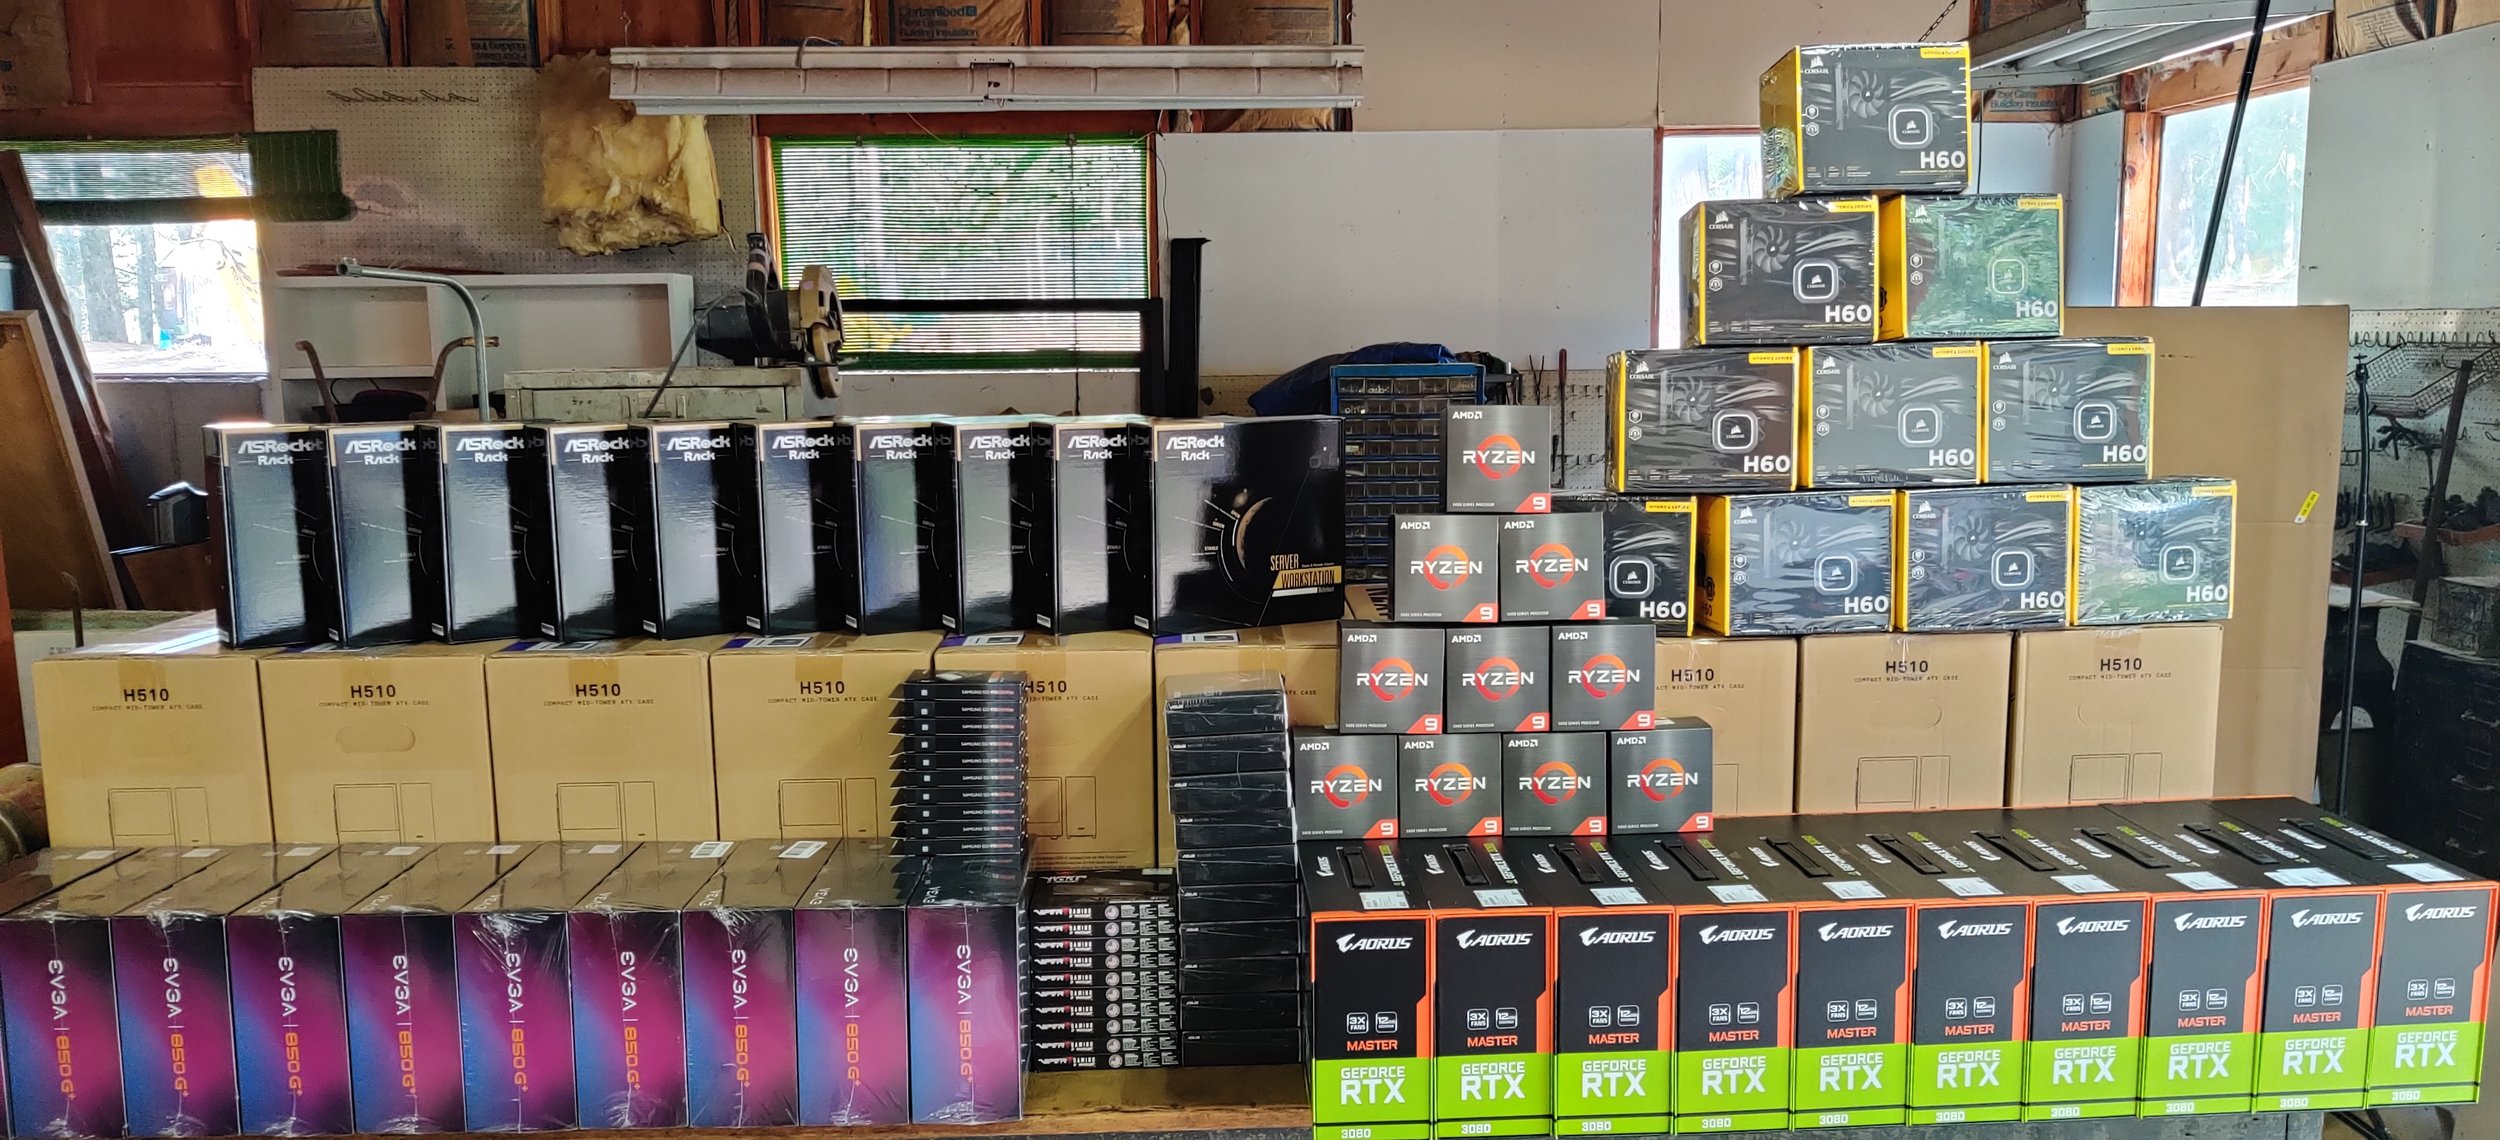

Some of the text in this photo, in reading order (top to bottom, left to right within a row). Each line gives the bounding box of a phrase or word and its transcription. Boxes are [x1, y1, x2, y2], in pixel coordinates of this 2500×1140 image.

[1921, 151, 1965, 168] H60
[1826, 305, 1871, 322] H60
[2016, 301, 2058, 317] H60
[1452, 411, 1474, 420] AMD
[238, 437, 312, 453] ASRock
[345, 437, 416, 453] ASRock
[456, 437, 523, 451] ASRock
[565, 437, 629, 452] ASRock
[666, 437, 730, 451] ASRock
[772, 436, 834, 449] ASRock
[869, 436, 932, 449] ASRock
[969, 436, 1030, 448] ASRock
[1068, 436, 1126, 448] ASRock
[1166, 436, 1224, 449] ASRock
[1463, 448, 1535, 464] RYZEN
[1929, 449, 1974, 467] H60
[2103, 445, 2147, 463] H60
[1744, 456, 1790, 472] H60
[1533, 497, 1546, 510] 9
[1400, 521, 1422, 530] AMD
[1504, 521, 1526, 529] AMD
[1270, 554, 1299, 571] SERVER
[1411, 558, 1482, 574] RYZEN
[1516, 557, 1588, 573] RYZEN
[1281, 570, 1335, 588] WORKSTATION
[2021, 591, 2064, 609] H60
[2186, 585, 2228, 602] H60
[1587, 604, 1600, 616] 9
[1640, 602, 1685, 618] H60
[1844, 596, 1888, 614] H60
[1480, 607, 1493, 620] 9
[1347, 635, 1368, 644] AMD
[1452, 635, 1473, 644] AMD
[1558, 632, 1579, 641] AMD
[1886, 661, 1928, 673] H510
[2101, 658, 2141, 671] H510
[1357, 673, 1428, 686] RYZEN
[1463, 670, 1533, 686] RYZEN
[1569, 667, 1640, 683] RYZEN
[1672, 669, 1714, 681] H510
[351, 685, 395, 698] H510
[576, 684, 620, 697] H510
[801, 681, 844, 694] H510
[1024, 681, 1067, 693] H510
[123, 689, 169, 702] H510
[1425, 718, 1437, 731] 9
[1532, 716, 1544, 728] 9
[1638, 714, 1650, 726] 9
[1300, 742, 1321, 751] AMD
[1404, 741, 1426, 750] AMD
[1509, 739, 1530, 748] AMD
[1617, 737, 1638, 746] AMD
[1311, 779, 1381, 793] RYZEN
[1416, 777, 1485, 791] RYZEN
[1520, 776, 1590, 789] RYZEN
[1628, 773, 1697, 787] RYZEN
[1381, 823, 1393, 835] 9
[1485, 821, 1497, 832] 9
[1590, 820, 1601, 832] 9
[1696, 816, 1708, 828] 9
[2306, 912, 2363, 928] AORUS
[2420, 906, 2477, 921] AORUS
[2072, 920, 2131, 935] AORUS
[2189, 916, 2247, 931] AORUS
[1595, 930, 1656, 946] AORUS
[1715, 928, 1775, 944] AORUS
[1833, 926, 1893, 941] AORUS
[1953, 923, 2013, 939] AORUS
[1351, 937, 1412, 952] AORUS
[1472, 933, 1532, 948] AORUS
[732, 949, 748, 1008] EVGA
[843, 947, 859, 1007] EVGA
[956, 944, 972, 1003] EVGA
[163, 957, 182, 1018] EVGA
[278, 956, 298, 1016] EVGA
[392, 955, 411, 1015] EVGA
[506, 953, 524, 1013] EVGA
[619, 951, 637, 1011] EVGA
[48, 959, 68, 1020] EVGA
[2293, 1011, 2341, 1023] MASTER
[2405, 1005, 2452, 1016] MASTER
[2062, 1020, 2111, 1031] MASTER
[2178, 1016, 2226, 1027] MASTER
[1709, 1030, 1759, 1042] MASTER
[1827, 1027, 1876, 1038] MASTER
[1945, 1025, 1994, 1035] MASTER
[1468, 1036, 1517, 1046] MASTER
[1589, 1034, 1638, 1043] MASTER
[2285, 1037, 2345, 1051] GEFORCE
[2397, 1030, 2458, 1045] GEFORCE
[1347, 1040, 1397, 1050] MASTER
[2170, 1042, 2231, 1056] GEFORCE
[1820, 1052, 1883, 1066] GEFORCE
[1938, 1049, 2000, 1063] GEFORCE
[2053, 1045, 2116, 1060] GEFORCE
[2394, 1043, 2455, 1068] RTX
[1461, 1062, 1525, 1076] GEFORCE
[1582, 1059, 1646, 1072] GEFORCE
[1702, 1056, 1766, 1069] GEFORCE
[2168, 1054, 2230, 1079] RTX
[2282, 1050, 2343, 1075] RTX
[1341, 1065, 1405, 1080] GEFORCE
[1819, 1065, 1882, 1091] RTX
[1937, 1062, 1999, 1088] RTX
[2053, 1058, 2114, 1084] RTX
[1461, 1075, 1525, 1100] RTX
[1582, 1072, 1646, 1097] RTX
[1702, 1068, 1765, 1094] RTX
[1341, 1078, 1404, 1104] RTX
[2392, 1090, 2419, 1101] 3080
[2166, 1102, 2194, 1112] 3080
[2280, 1097, 2308, 1108] 3080
[1936, 1111, 1965, 1121] 3080
[2051, 1106, 2080, 1117] 3080
[1582, 1121, 1611, 1131] 3080
[1702, 1118, 1731, 1128] 3080
[1819, 1114, 1848, 1124] 3080
[1341, 1128, 1371, 1138] 3080
[1461, 1124, 1491, 1134] 3080
